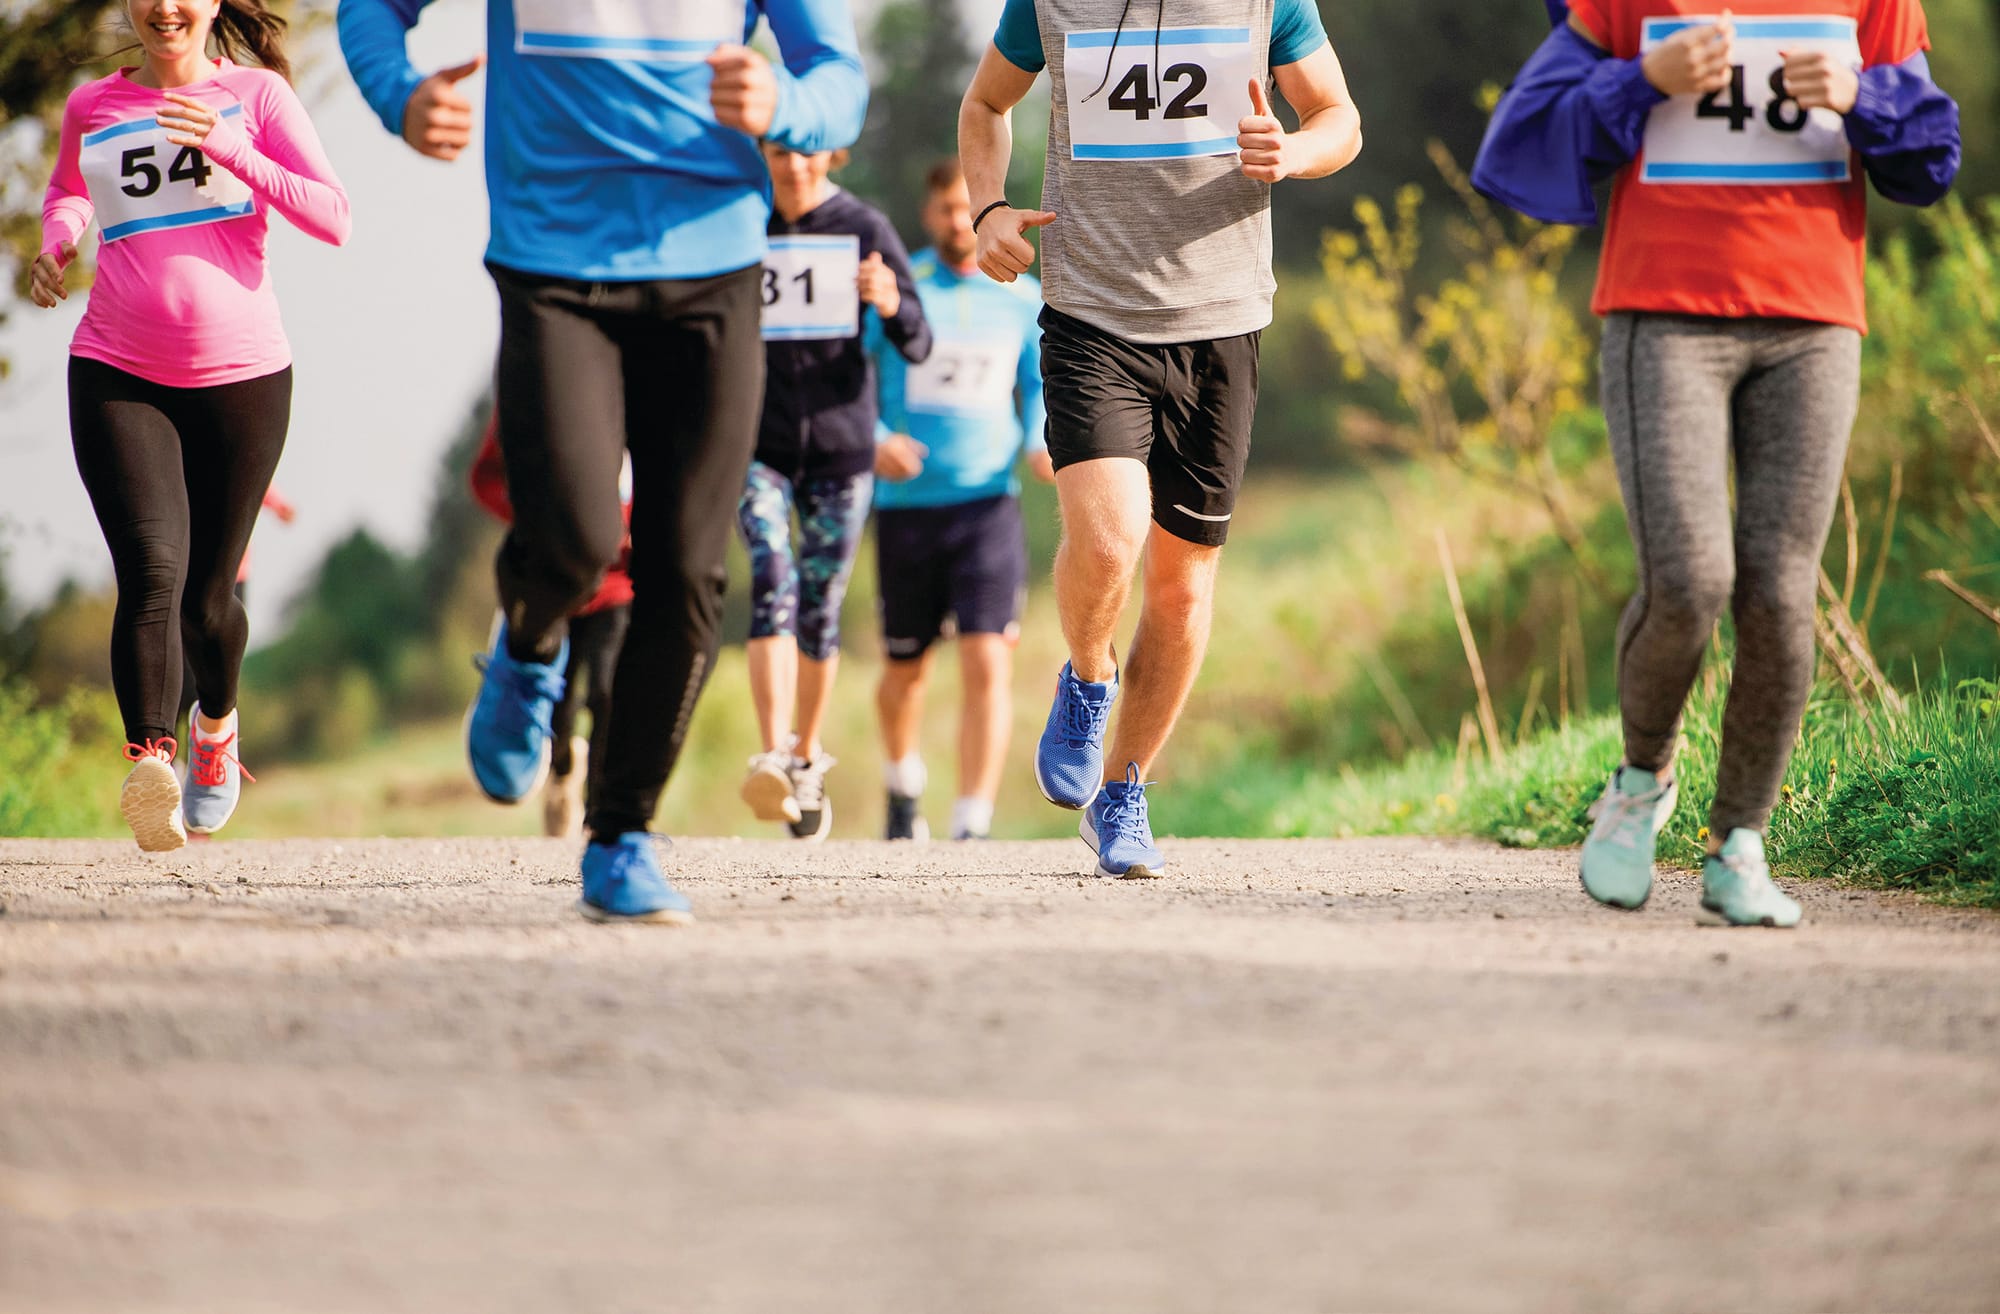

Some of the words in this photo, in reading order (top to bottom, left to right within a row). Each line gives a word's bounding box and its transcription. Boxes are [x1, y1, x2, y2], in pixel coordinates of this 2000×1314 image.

[1108, 62, 1208, 121] 42
[1695, 64, 1808, 132] 48
[121, 145, 212, 198] 54
